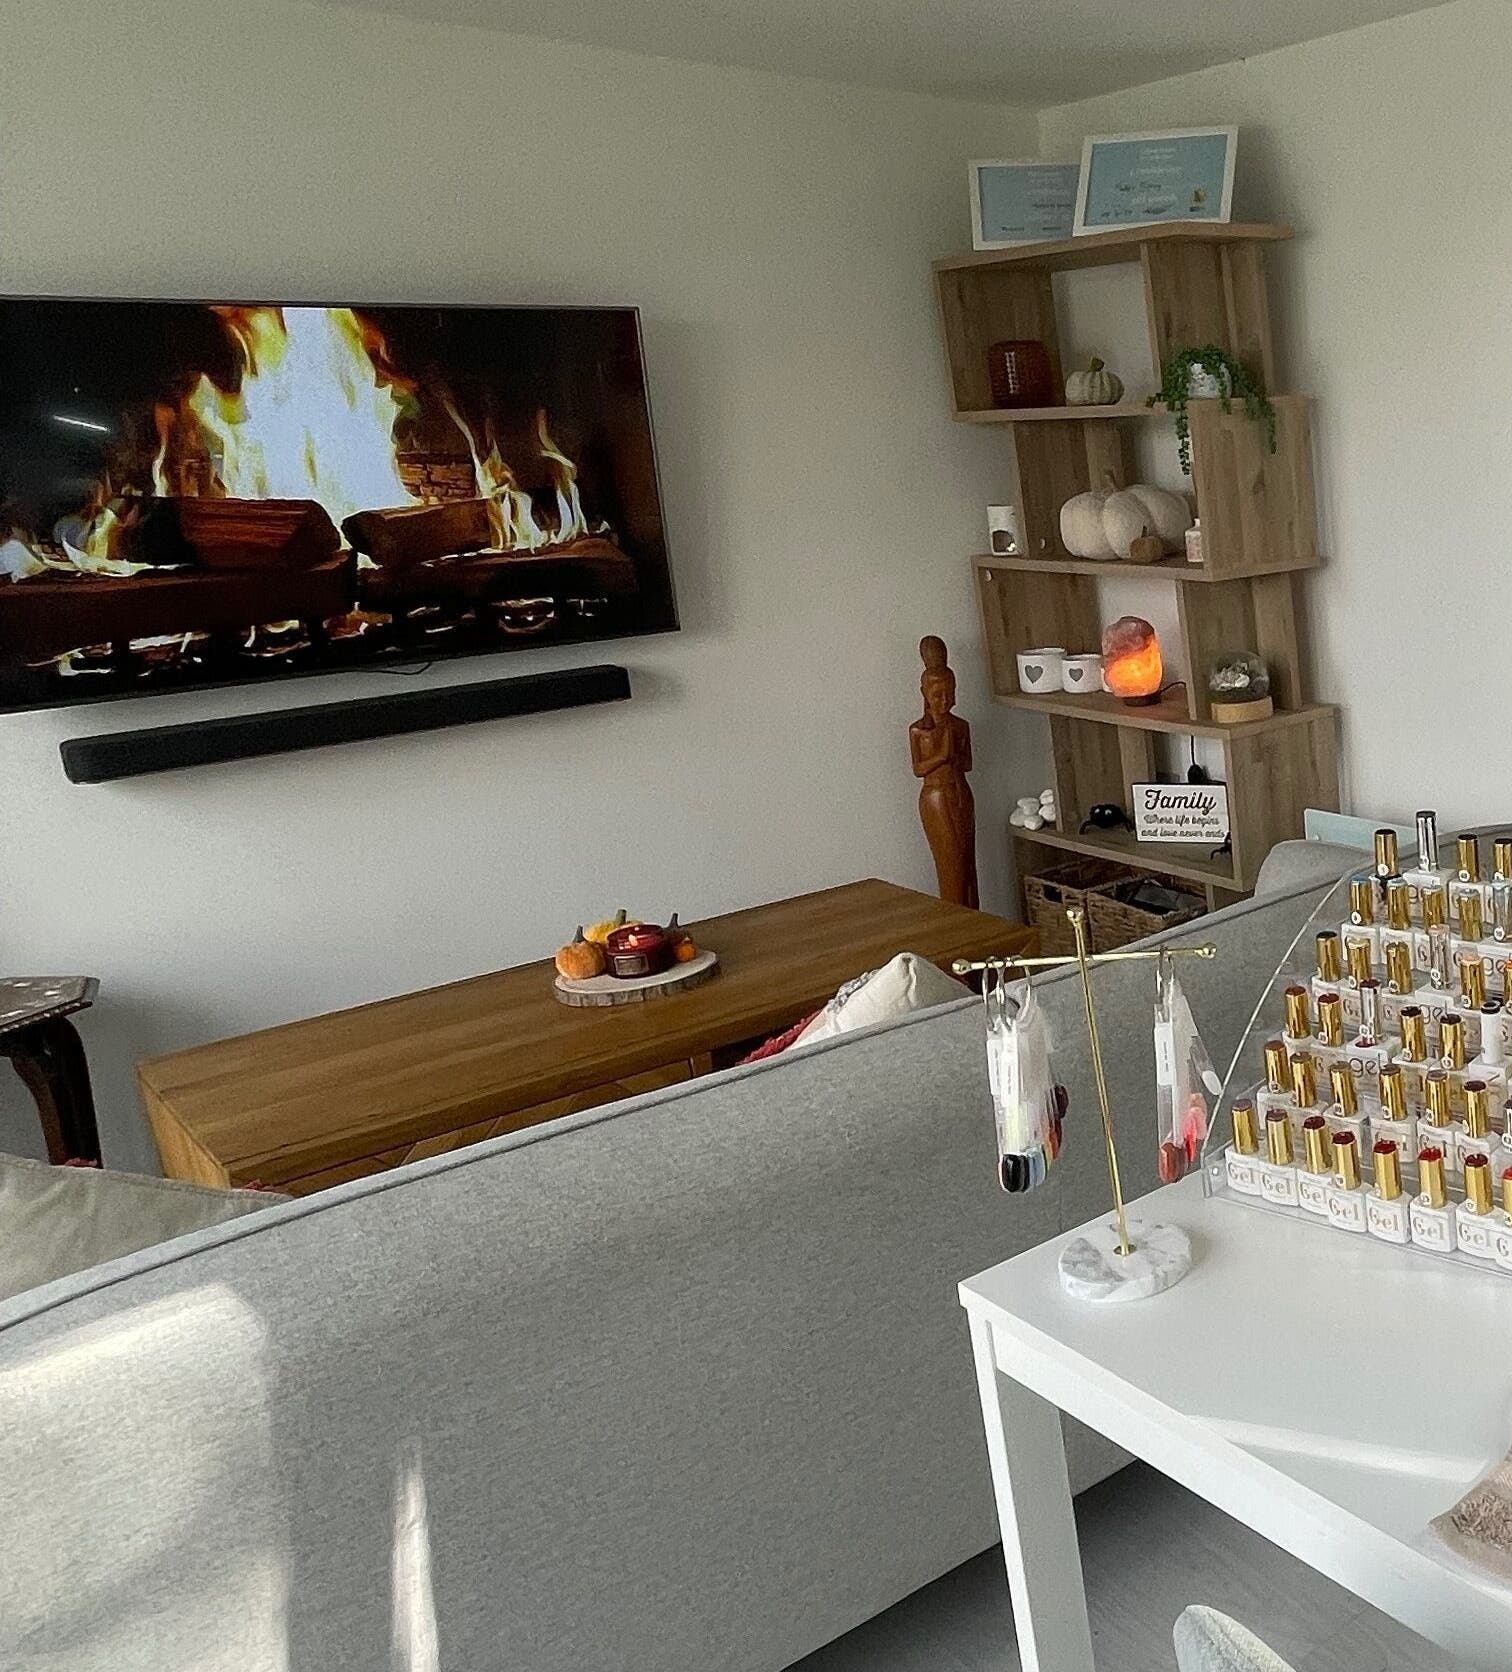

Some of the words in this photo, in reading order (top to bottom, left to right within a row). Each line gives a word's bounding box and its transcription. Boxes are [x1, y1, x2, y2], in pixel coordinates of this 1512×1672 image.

[1145, 789, 1217, 815] Family
[1141, 828, 1158, 837] and
[1160, 829, 1177, 837] love
[1179, 830, 1203, 838] never
[1205, 829, 1225, 838] ends
[1144, 814, 1174, 825] Where
[1175, 814, 1190, 827] life
[1192, 815, 1219, 829] begins
[1349, 1052, 1382, 1078] gel
[1228, 1161, 1255, 1185] Gel
[1262, 1173, 1291, 1195] Gel
[1299, 1181, 1328, 1204] Gel
[1328, 1197, 1359, 1221] Gel
[1368, 1205, 1399, 1232] Gel
[1412, 1216, 1445, 1241] Gel
[1458, 1222, 1491, 1248] Gel
